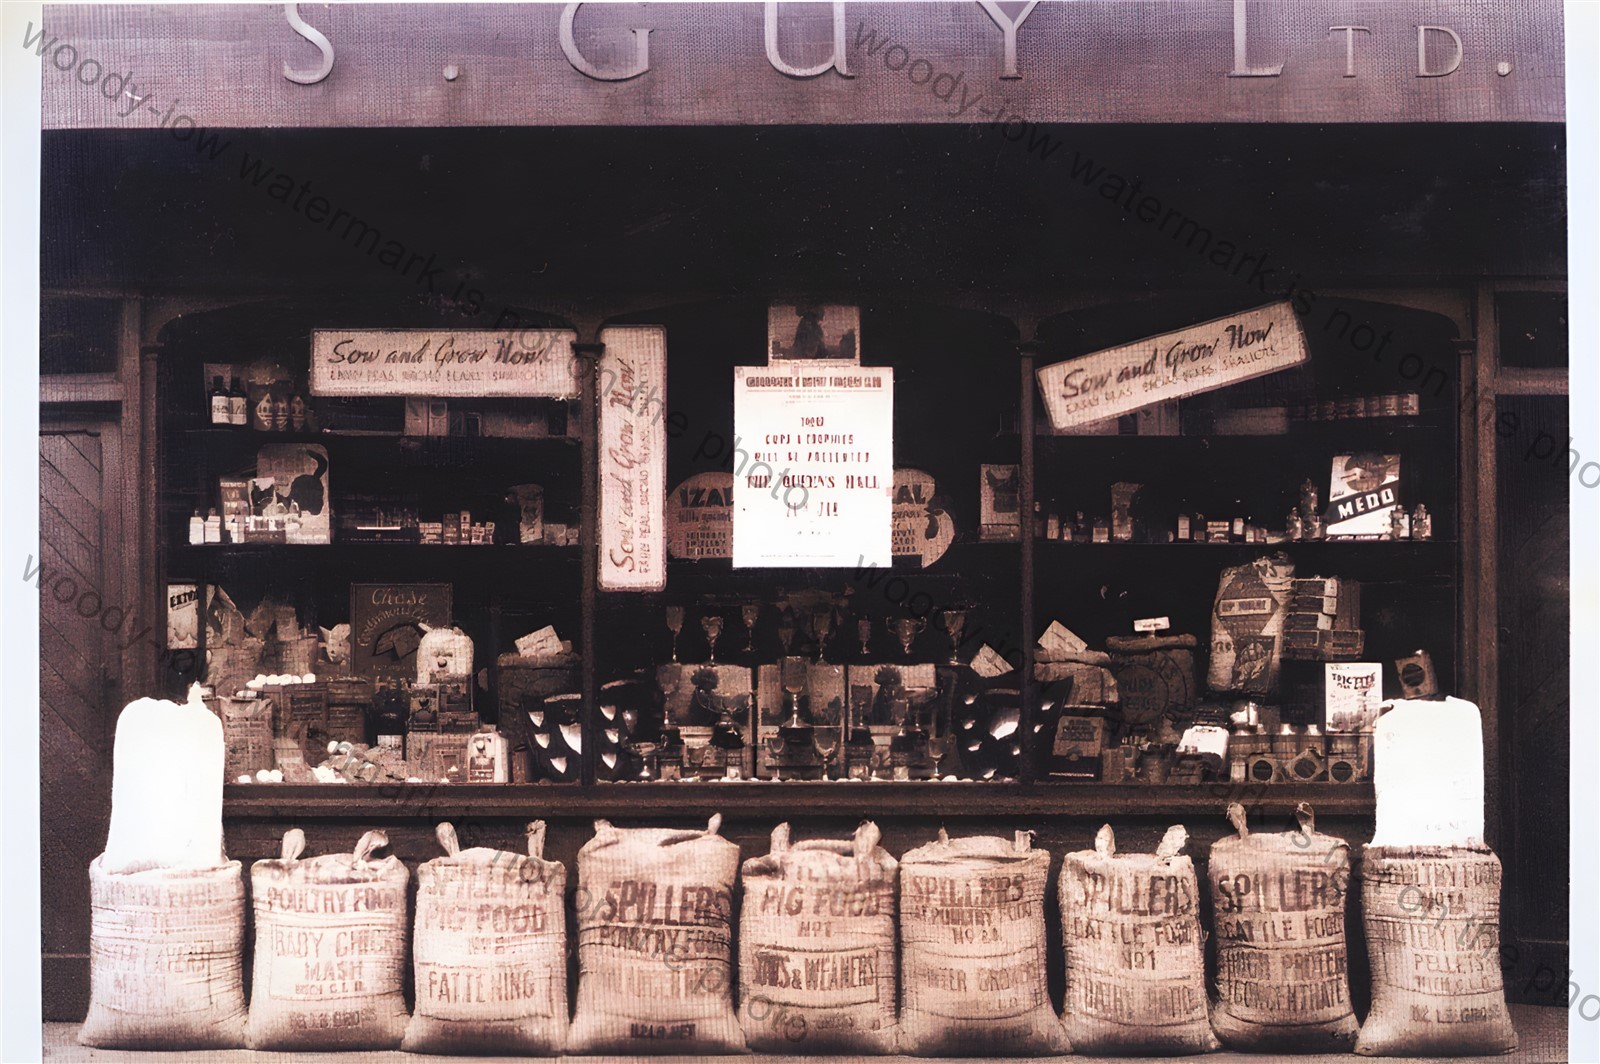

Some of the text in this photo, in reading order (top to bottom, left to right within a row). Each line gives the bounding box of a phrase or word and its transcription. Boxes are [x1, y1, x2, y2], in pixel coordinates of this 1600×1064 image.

[328, 339, 380, 364] Sow
[385, 338, 430, 364] and
[434, 337, 488, 371] Grow
[1062, 367, 1113, 399] Sow
[1117, 348, 1157, 383] and
[1166, 338, 1219, 374] Grow
[1337, 487, 1395, 519] MEDO
[1218, 869, 1349, 915] SPILLERS
[476, 903, 546, 933] FOOD
